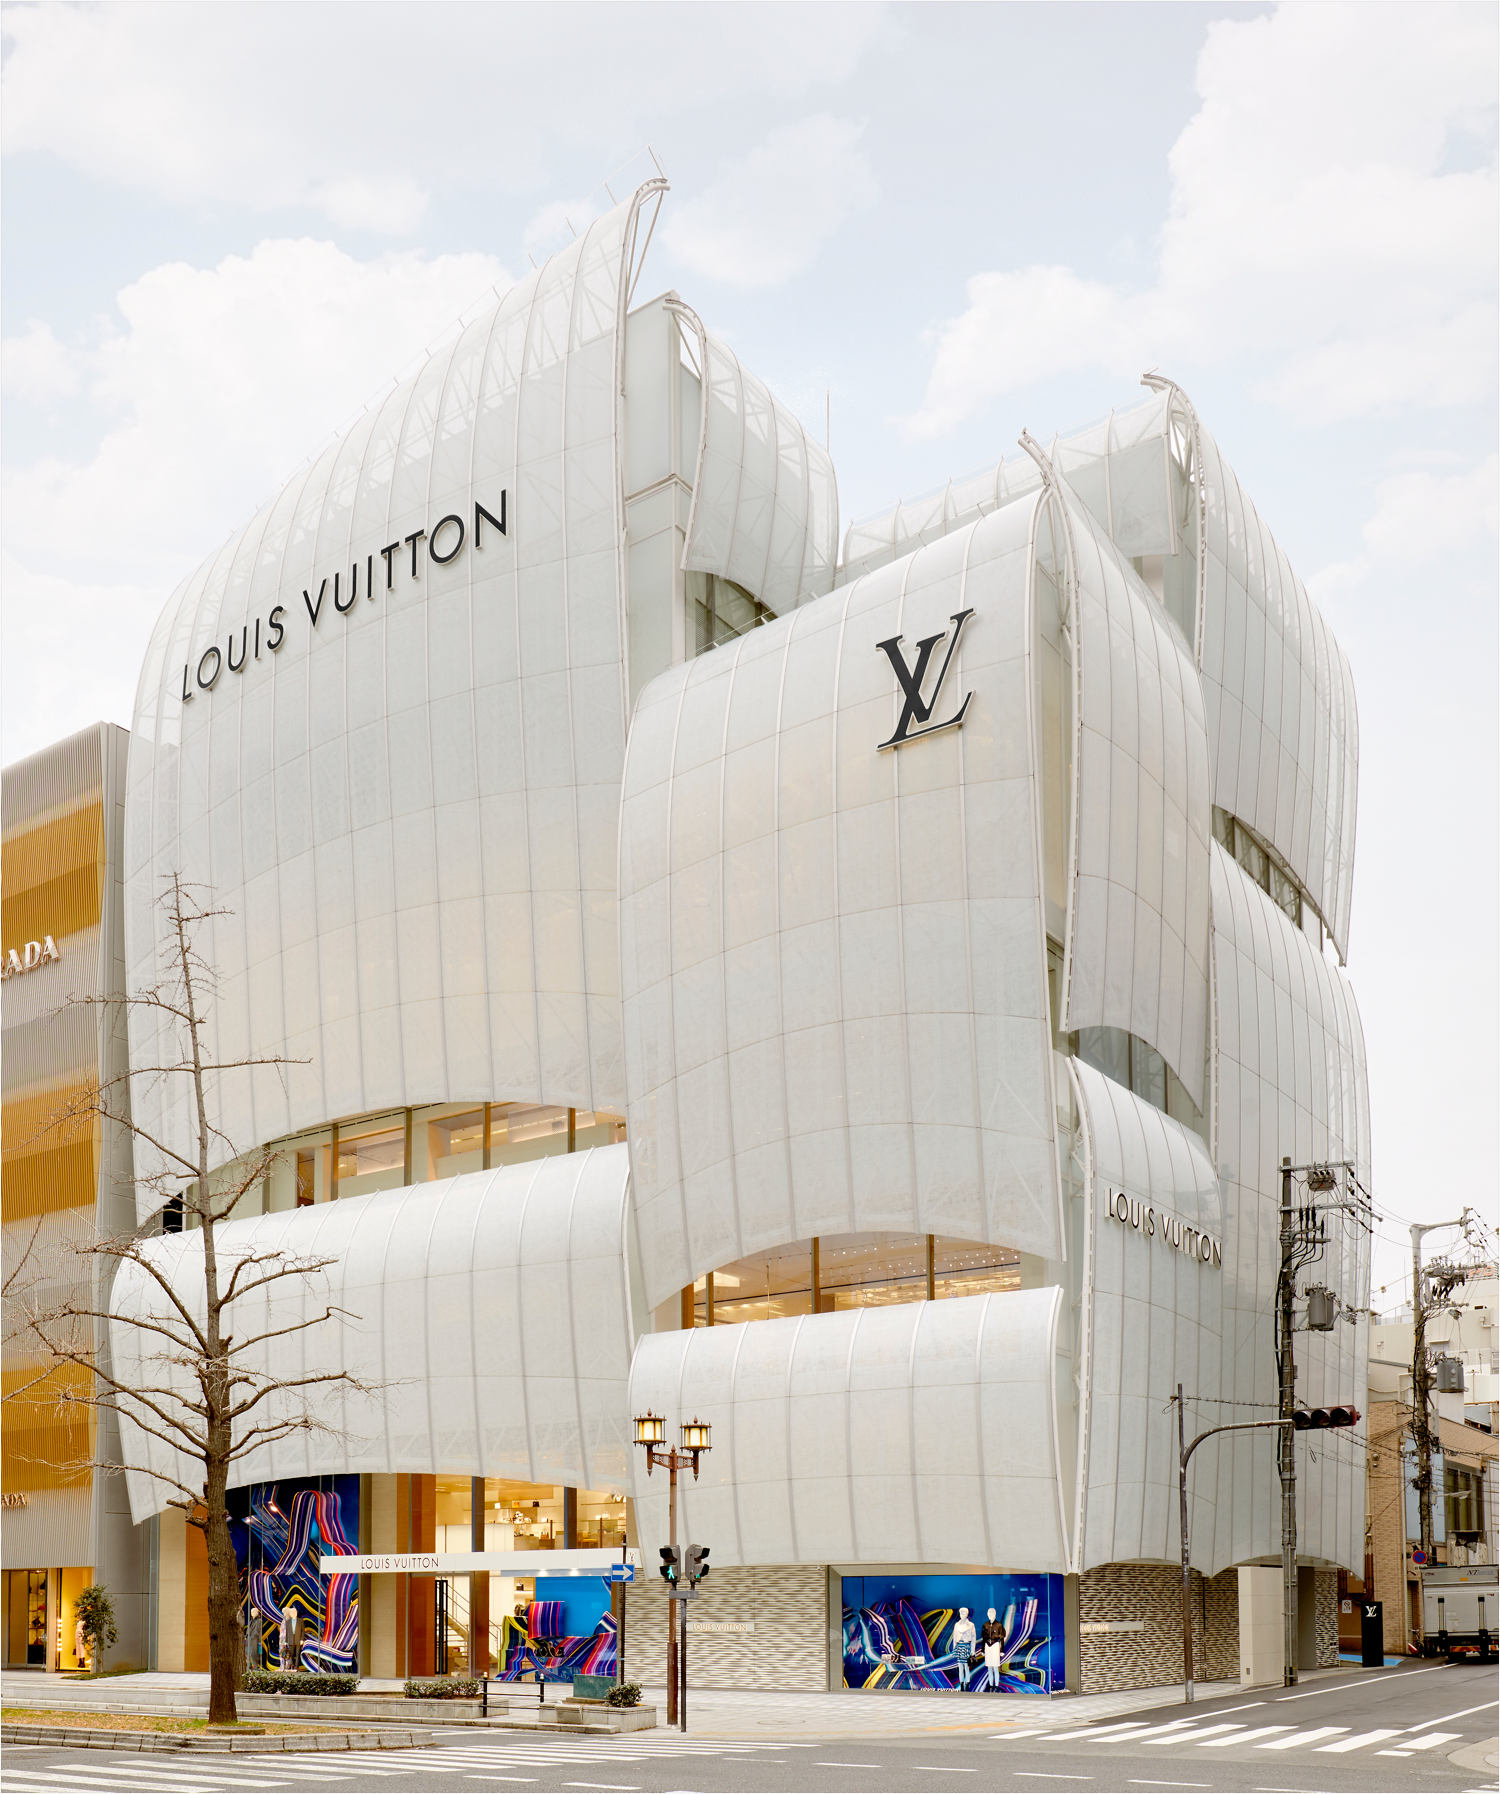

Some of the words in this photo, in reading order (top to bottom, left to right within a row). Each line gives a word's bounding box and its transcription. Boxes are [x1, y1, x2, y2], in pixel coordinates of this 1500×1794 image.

[182, 605, 286, 703] LOUIS
[302, 489, 508, 628] VUITTON
[1104, 1187, 1155, 1237] LOUIS
[1157, 1213, 1222, 1270] VUITTON
[361, 1558, 390, 1569] LOUIS
[394, 1557, 439, 1568] VUITTON
[692, 1623, 713, 1631] LOUIS
[715, 1623, 747, 1631] VUITTON
